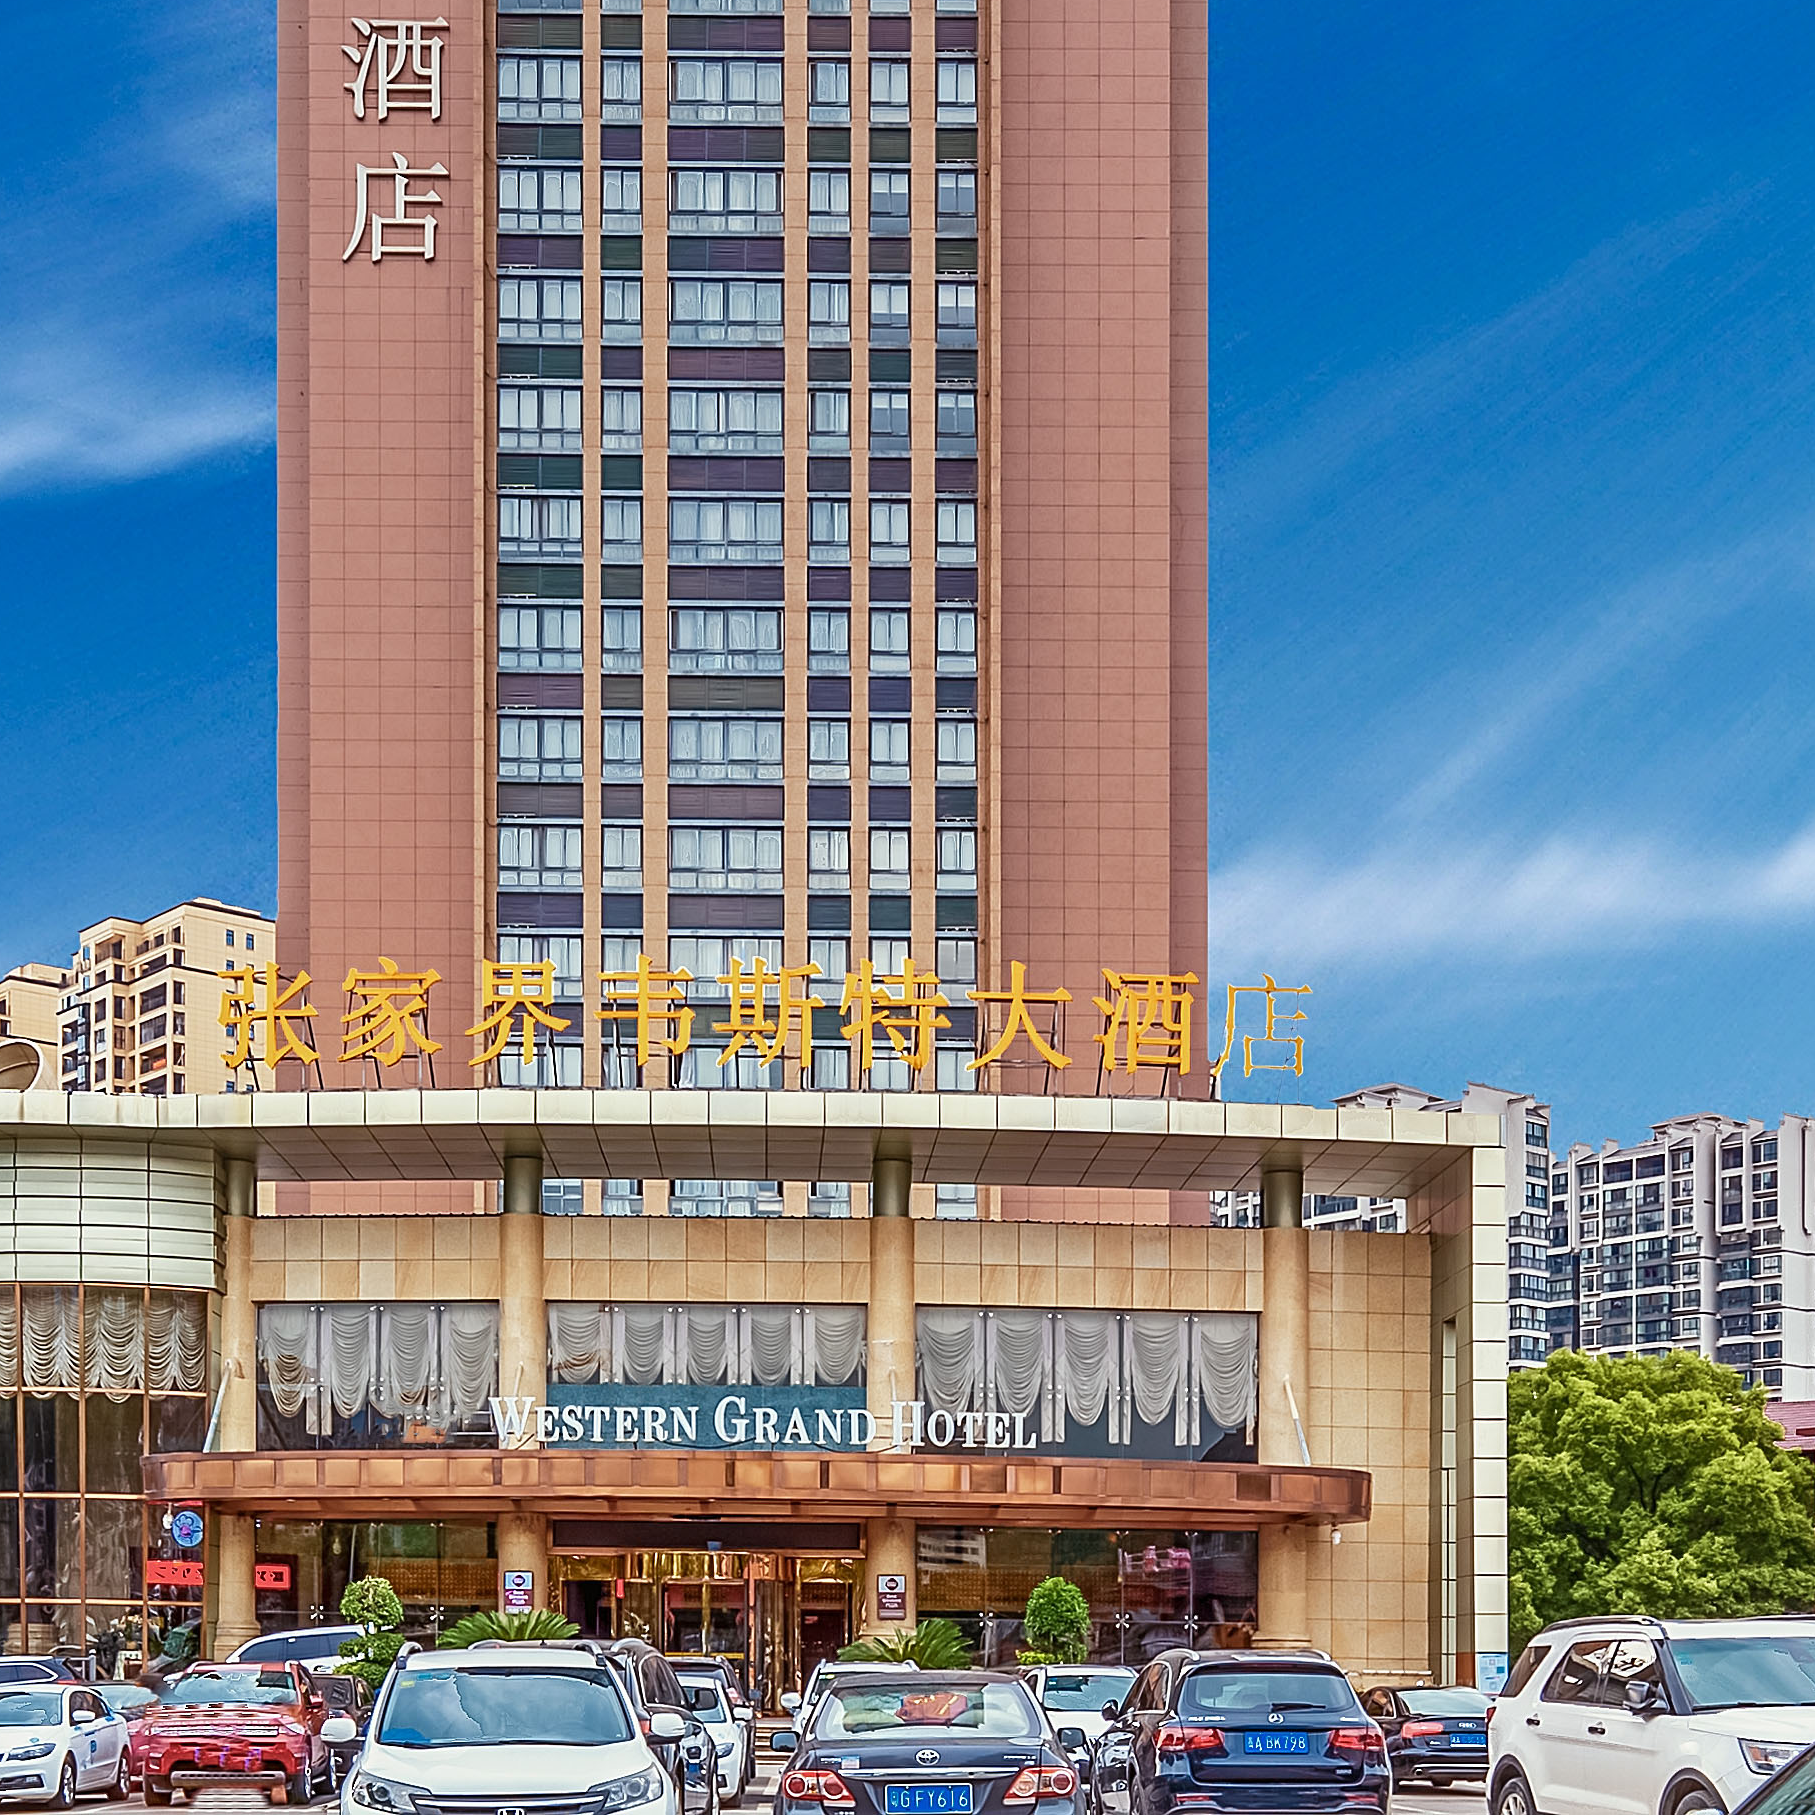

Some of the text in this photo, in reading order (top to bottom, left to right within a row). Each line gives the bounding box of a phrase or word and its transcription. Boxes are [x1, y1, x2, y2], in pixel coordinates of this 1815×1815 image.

[217, 954, 1313, 1079] 张家界韦斯特大酒店
[488, 1395, 1038, 1449] WESTERN GRAND HOTEL
